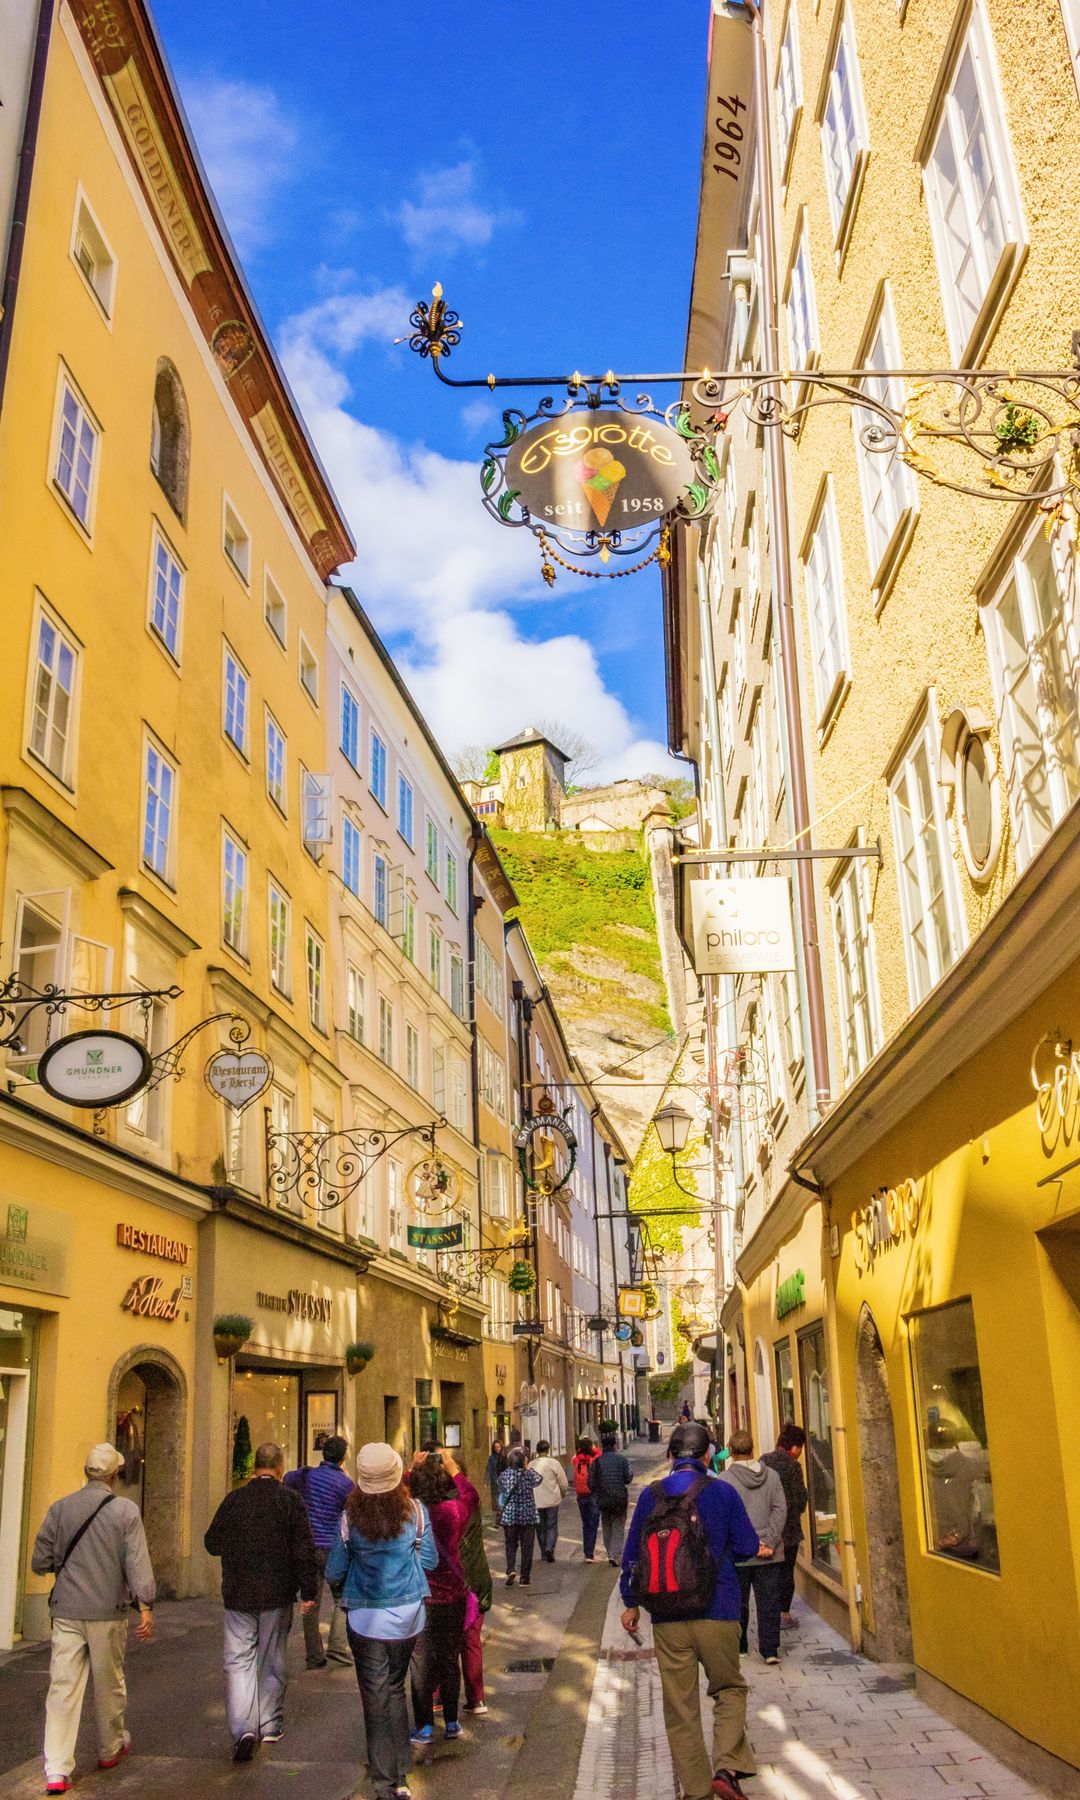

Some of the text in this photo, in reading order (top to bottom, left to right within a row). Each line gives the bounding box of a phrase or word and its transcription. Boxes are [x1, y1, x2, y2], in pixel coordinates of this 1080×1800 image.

[713, 94, 747, 182] 1964
[126, 103, 193, 256] GOLDENER
[520, 424, 677, 474] Eisgrotte
[267, 433, 310, 517] HIRSCH
[544, 498, 665, 517] seit 1958
[706, 929, 781, 953] philoro
[66, 1065, 123, 1076] GMUNDNER
[211, 1065, 267, 1078] Restaurant
[518, 1115, 573, 1142] SALAMANDER
[120, 1226, 192, 1266] RESTAURANT
[411, 1230, 458, 1244] STASSNY
